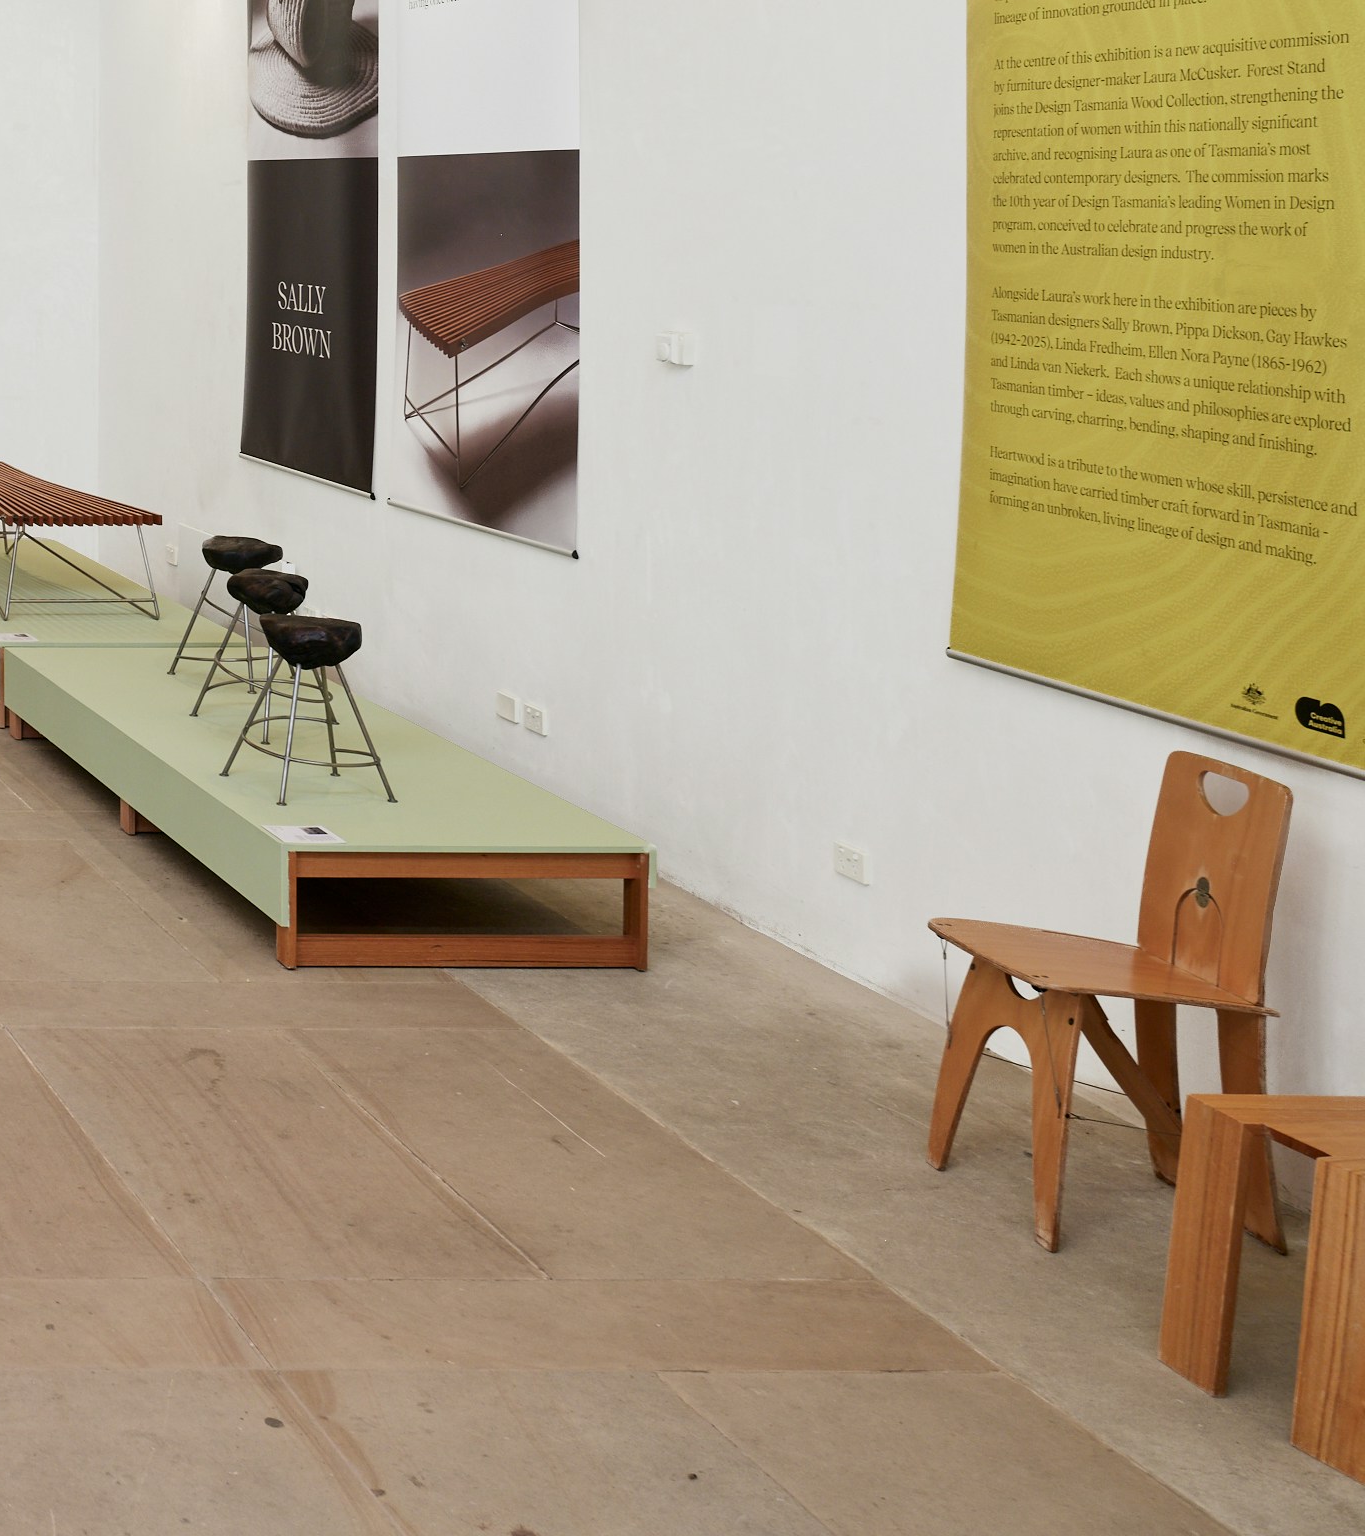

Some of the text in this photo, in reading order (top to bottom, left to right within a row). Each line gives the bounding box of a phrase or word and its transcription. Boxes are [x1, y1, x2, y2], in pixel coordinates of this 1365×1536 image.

[994, 12, 1027, 24] lineage
[1028, 6, 1040, 20] of
[1042, 3, 1099, 19] innovation
[993, 113, 1317, 140] representation of women within this nationally significant
[993, 167, 1329, 186] celebrated contemporary designers. The commission marks
[993, 194, 1007, 206] the
[1009, 194, 1030, 206] 10th
[1033, 198, 1056, 209] year
[1057, 194, 1070, 207] of
[1072, 195, 1109, 210] Design
[1178, 195, 1221, 211] leading
[1224, 195, 1270, 208] Women
[1274, 195, 1285, 208] in
[1289, 195, 1335, 212] Design
[992, 241, 1213, 262] women in the Australian design industry.
[277, 280, 326, 315] SALLY
[991, 286, 1039, 302] Alongside
[1082, 292, 1110, 304] work
[1113, 292, 1137, 306] here
[1140, 294, 1150, 307] in
[1153, 295, 1172, 309] the
[1174, 297, 1234, 313] exhibition
[1237, 304, 1257, 314] are
[1259, 302, 1297, 318] pieces
[1300, 303, 1316, 321] by
[272, 322, 331, 359] BROWN
[990, 355, 1345, 403] and Linda van Niekerk. Each shows a unique relationship with
[989, 490, 1029, 511] forming
[1031, 502, 1044, 512] an
[1103, 511, 1135, 531] living
[1137, 517, 1179, 538] lineage
[1181, 526, 1193, 539] of
[1195, 528, 1235, 549] design
[1238, 539, 1261, 553] and
[1265, 544, 1316, 566] making.
[1308, 720, 1343, 735] Australia
[1310, 712, 1342, 726] Creative
